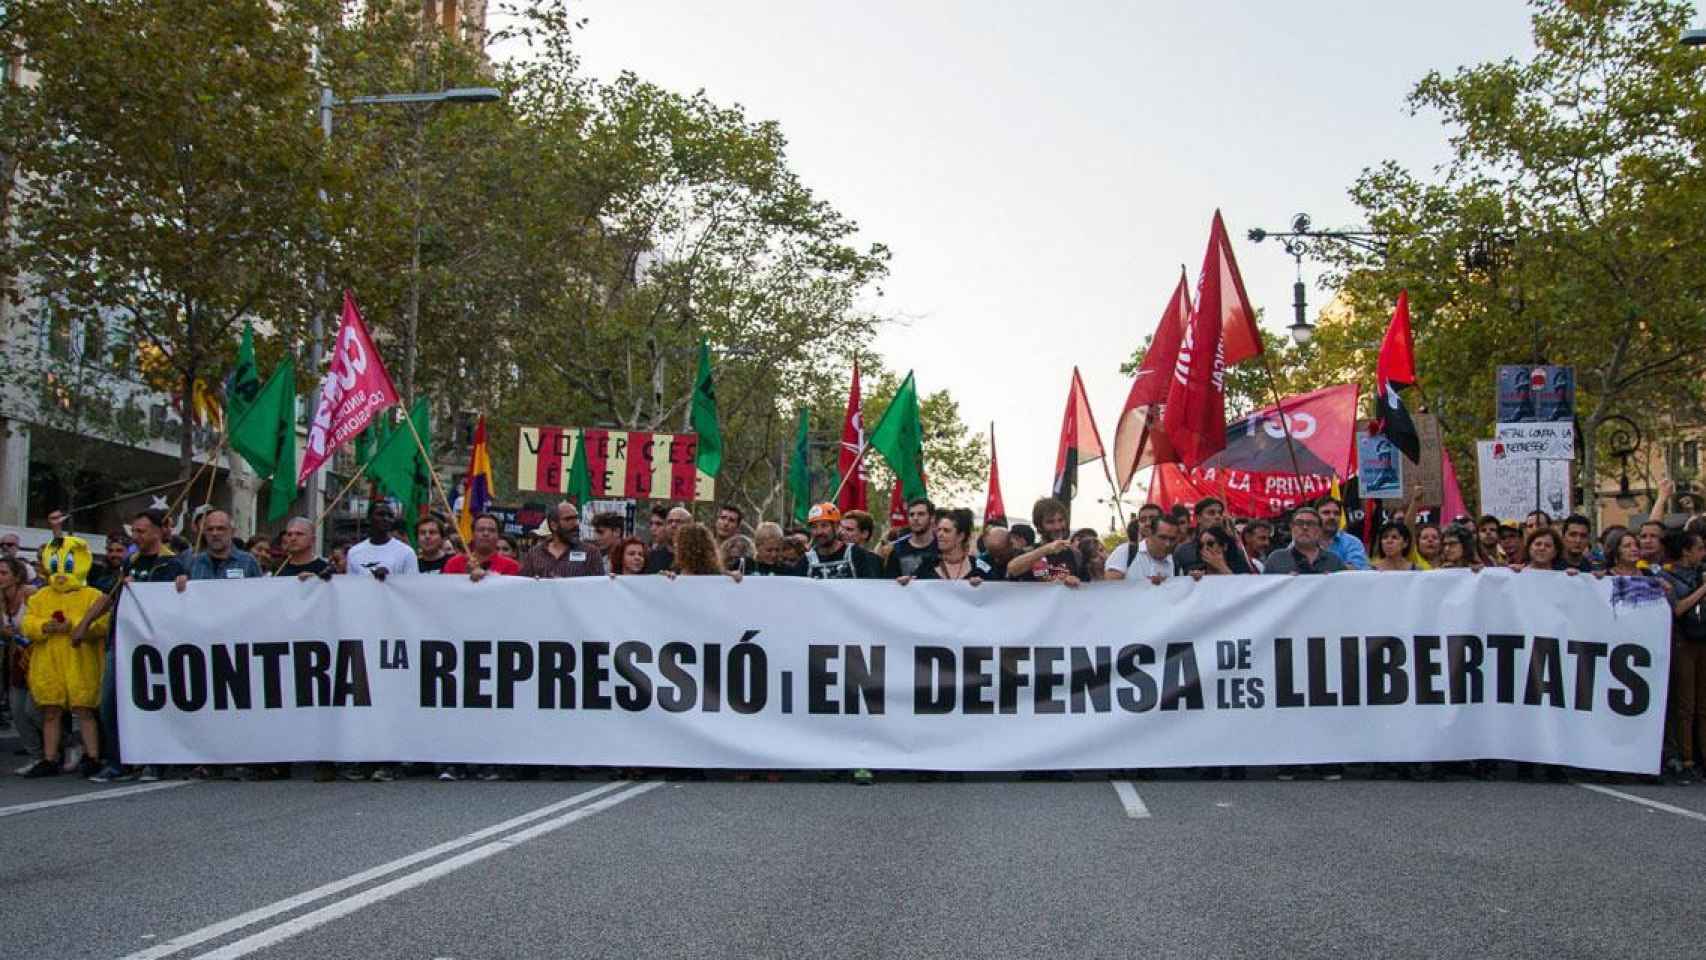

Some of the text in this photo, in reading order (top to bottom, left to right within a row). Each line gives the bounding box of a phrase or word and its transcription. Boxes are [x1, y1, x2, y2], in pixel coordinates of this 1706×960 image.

[641, 440, 697, 463] C'ES
[1228, 470, 1250, 492] LA
[131, 630, 1653, 716] CONTRA LA REPRESSIÓ I EN DEFENSA DE LES LLIBERTATS
